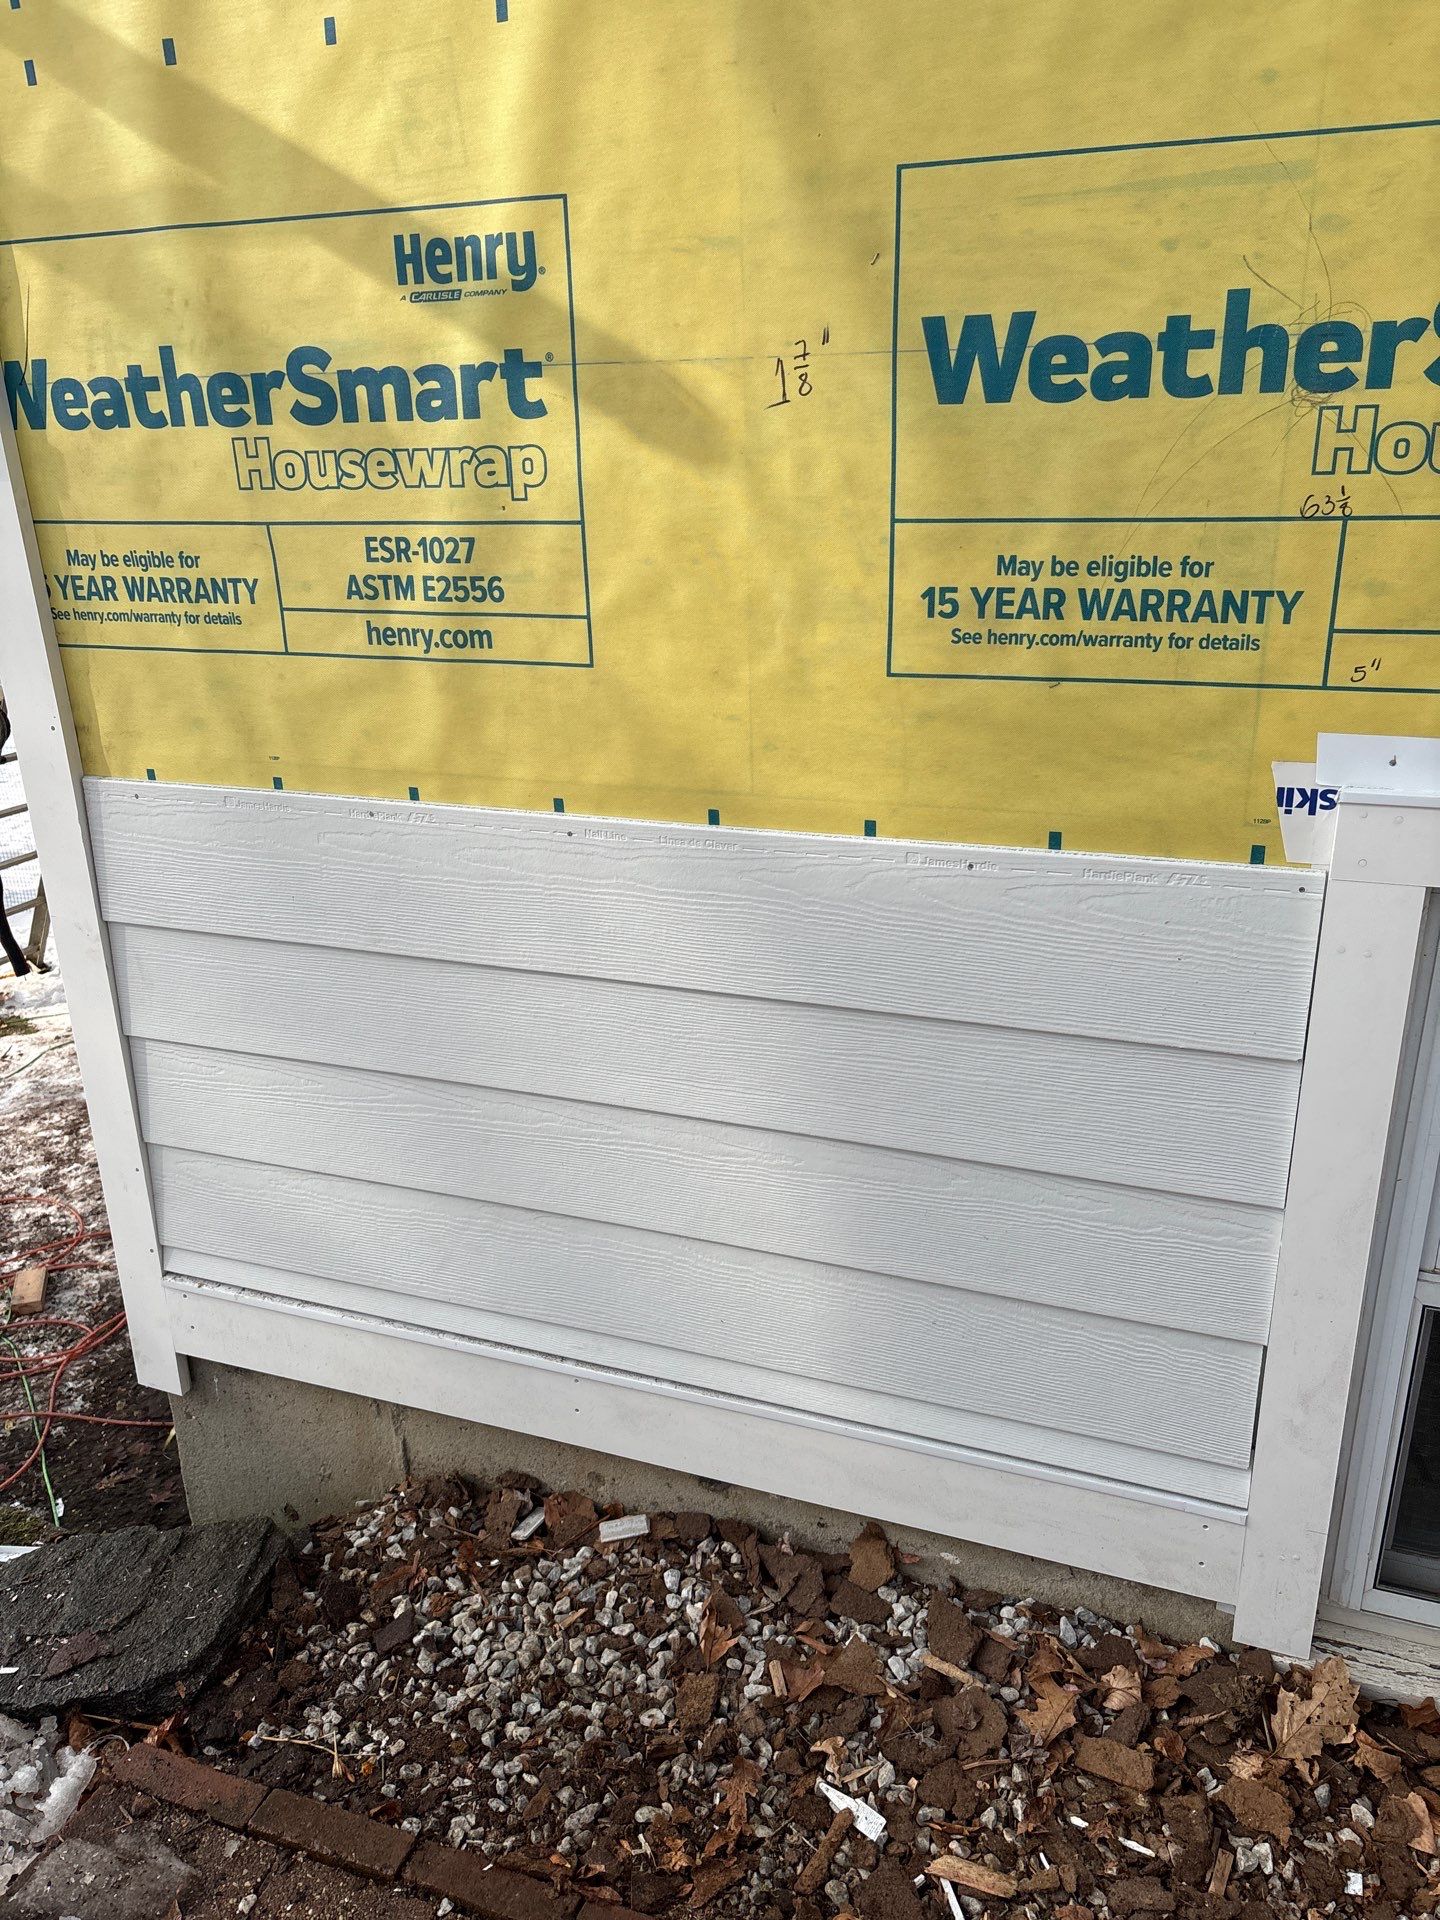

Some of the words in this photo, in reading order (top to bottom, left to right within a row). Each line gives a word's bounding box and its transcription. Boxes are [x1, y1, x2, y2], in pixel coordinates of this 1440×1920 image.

[393, 230, 538, 292] Henry
[400, 294, 407, 302] A
[411, 289, 461, 303] CARLISLE
[464, 288, 508, 298] COMPANY
[920, 288, 1440, 405] Weather
[1311, 404, 1440, 476] Ho
[232, 437, 548, 502] Housewrap
[66, 549, 97, 571] May
[100, 550, 119, 568] be
[123, 550, 174, 572] eligible
[177, 552, 200, 570] for
[364, 536, 476, 566] ESR-1027
[996, 554, 1045, 582] May
[1050, 555, 1080, 578] be
[1086, 556, 1173, 584] eligible
[1179, 556, 1215, 579] for
[54, 574, 119, 602] YEAR
[122, 576, 259, 605] WARRANTY
[346, 574, 416, 602] ASTM
[422, 576, 506, 603] E2556
[51, 606, 71, 621] See
[73, 607, 182, 627] henry.com/warranty
[184, 609, 200, 626] for
[204, 610, 243, 627] details
[920, 586, 960, 620] 15
[969, 586, 1066, 622] YEAR
[1077, 588, 1305, 626] WARRANTY
[366, 620, 493, 654] henry.com
[951, 628, 983, 646] See
[986, 628, 1163, 653] henry.com/warranty
[1167, 630, 1194, 650] for
[1198, 631, 1261, 653] details
[349, 808, 402, 823] HardePlank
